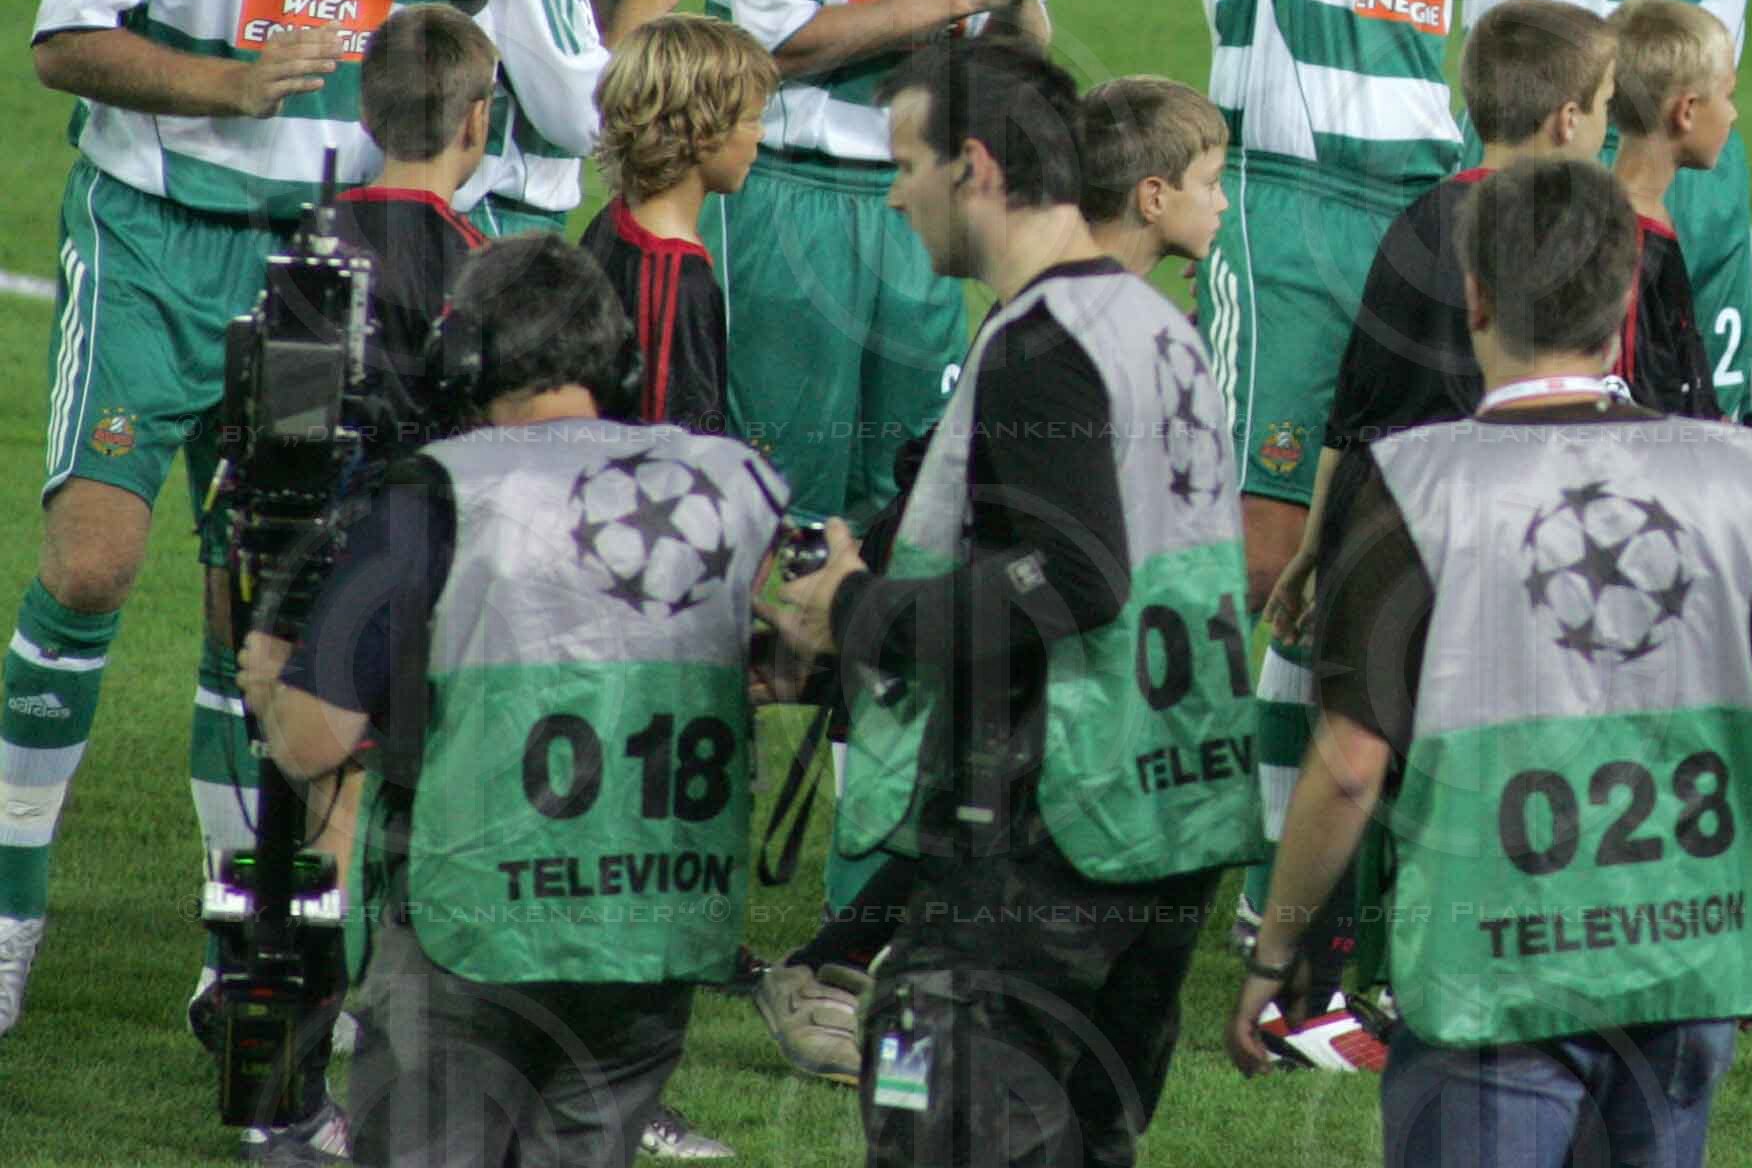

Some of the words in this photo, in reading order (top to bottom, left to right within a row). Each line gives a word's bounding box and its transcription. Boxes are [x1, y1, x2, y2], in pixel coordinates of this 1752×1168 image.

[1135, 592, 1252, 712] 01
[522, 712, 736, 822] 018
[1498, 748, 1736, 877] 028
[497, 849, 735, 903] TELEVION
[1479, 887, 1746, 960] TELEVISION
